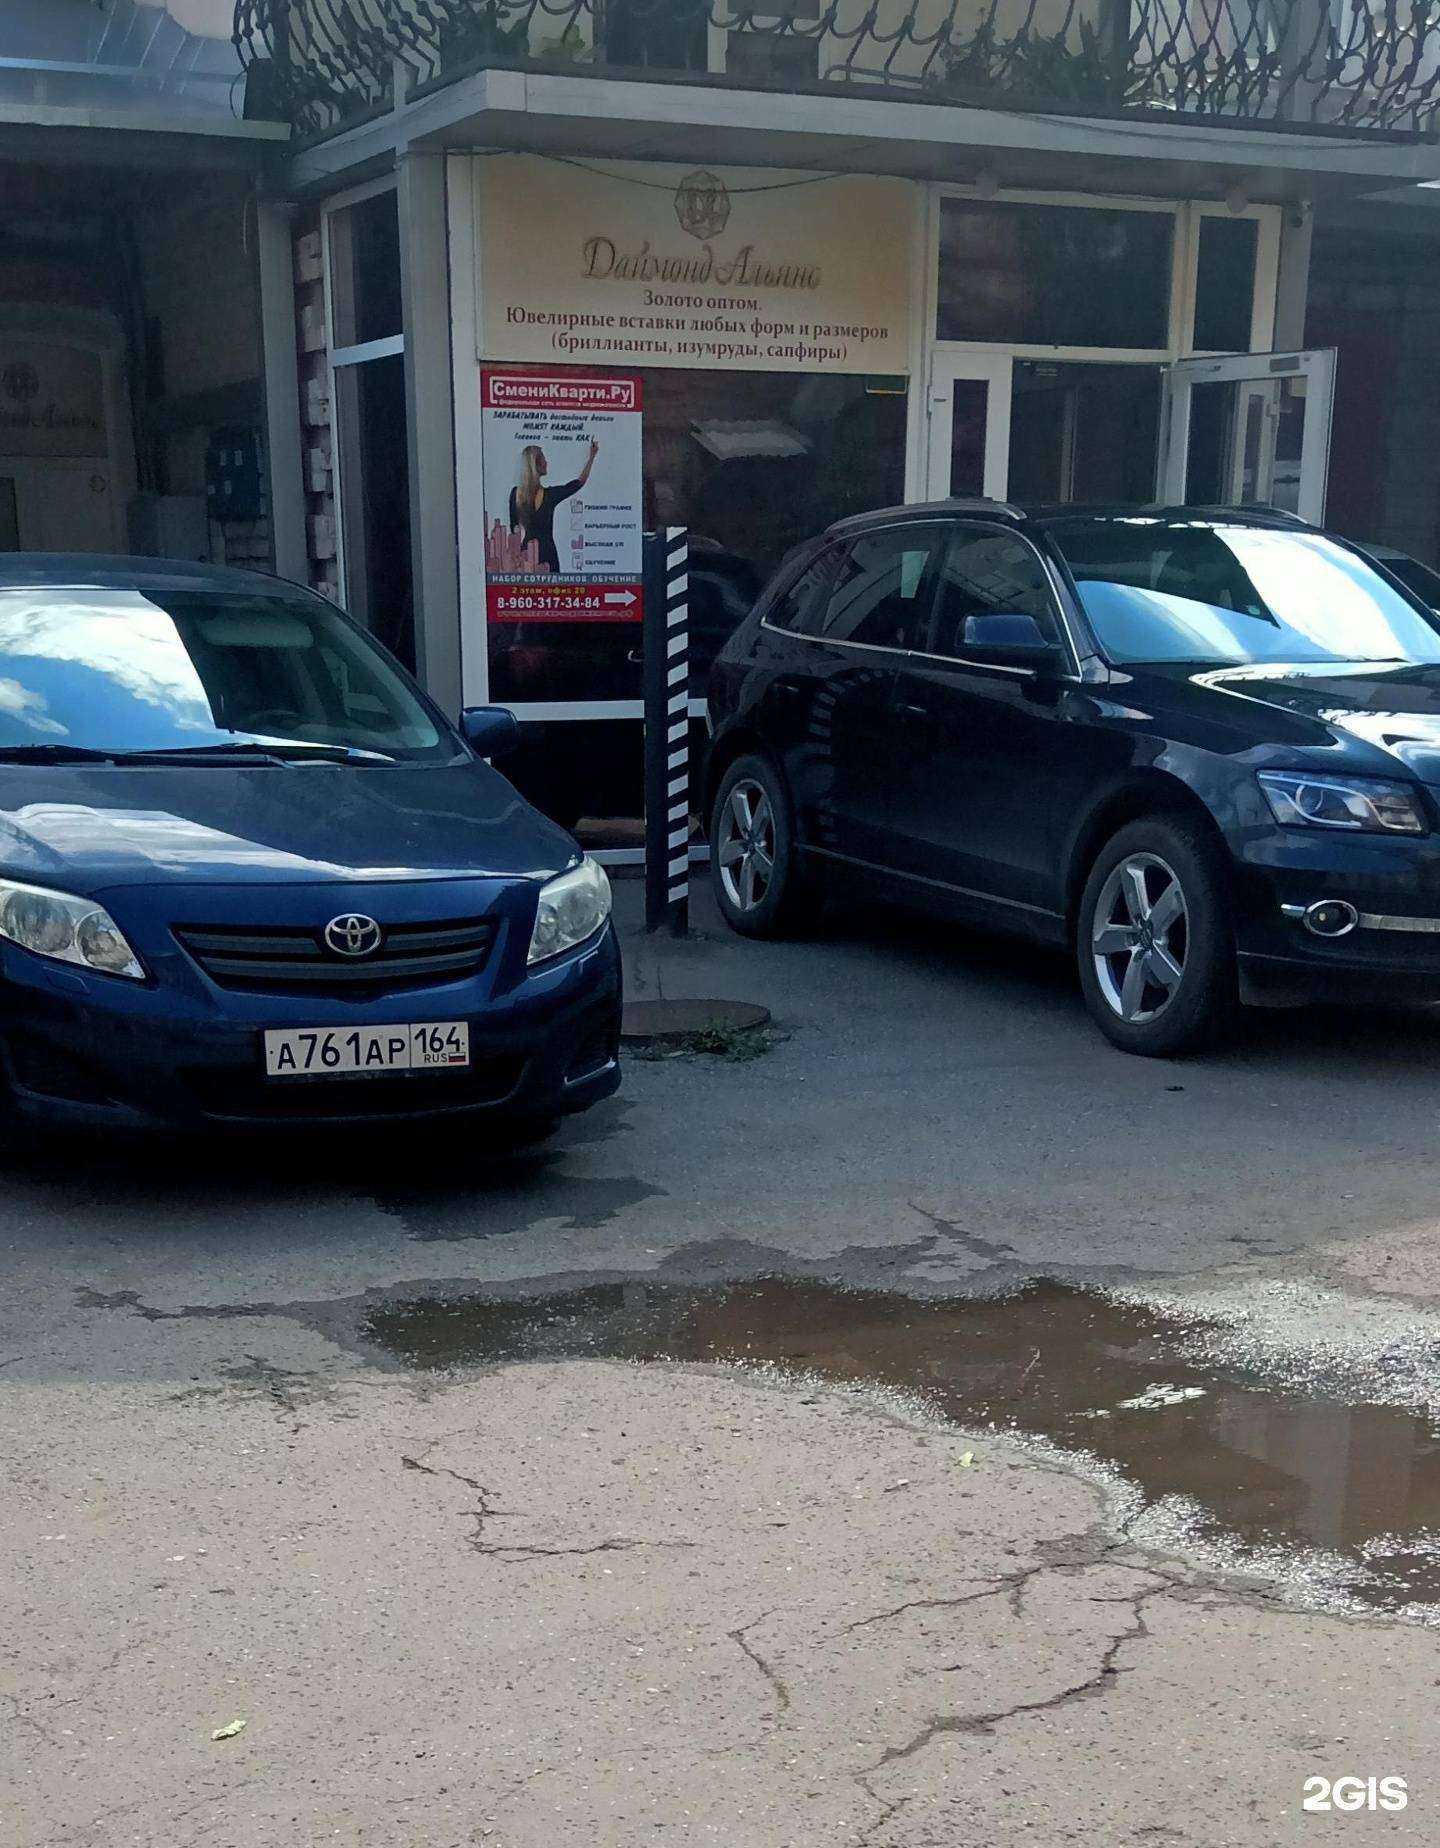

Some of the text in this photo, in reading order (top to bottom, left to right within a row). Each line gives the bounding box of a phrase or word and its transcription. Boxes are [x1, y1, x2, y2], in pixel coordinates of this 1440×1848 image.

[582, 236, 821, 290] Даймонд Альянс
[643, 289, 762, 311] Золото оптом.
[506, 306, 889, 342] Ювелирные вставки любых форм и размеров
[551, 331, 848, 362] (бриллианты, изумруды, сапфиры)
[493, 381, 630, 403] СмениКварти.Ру
[492, 574, 637, 583] НАБОР СОТРУДНИКОВ ОБУЧЕНИЕ
[497, 596, 601, 608] 8-960-317-34-84
[277, 1026, 461, 1070] А761АР 164
[424, 1053, 448, 1063] RUS
